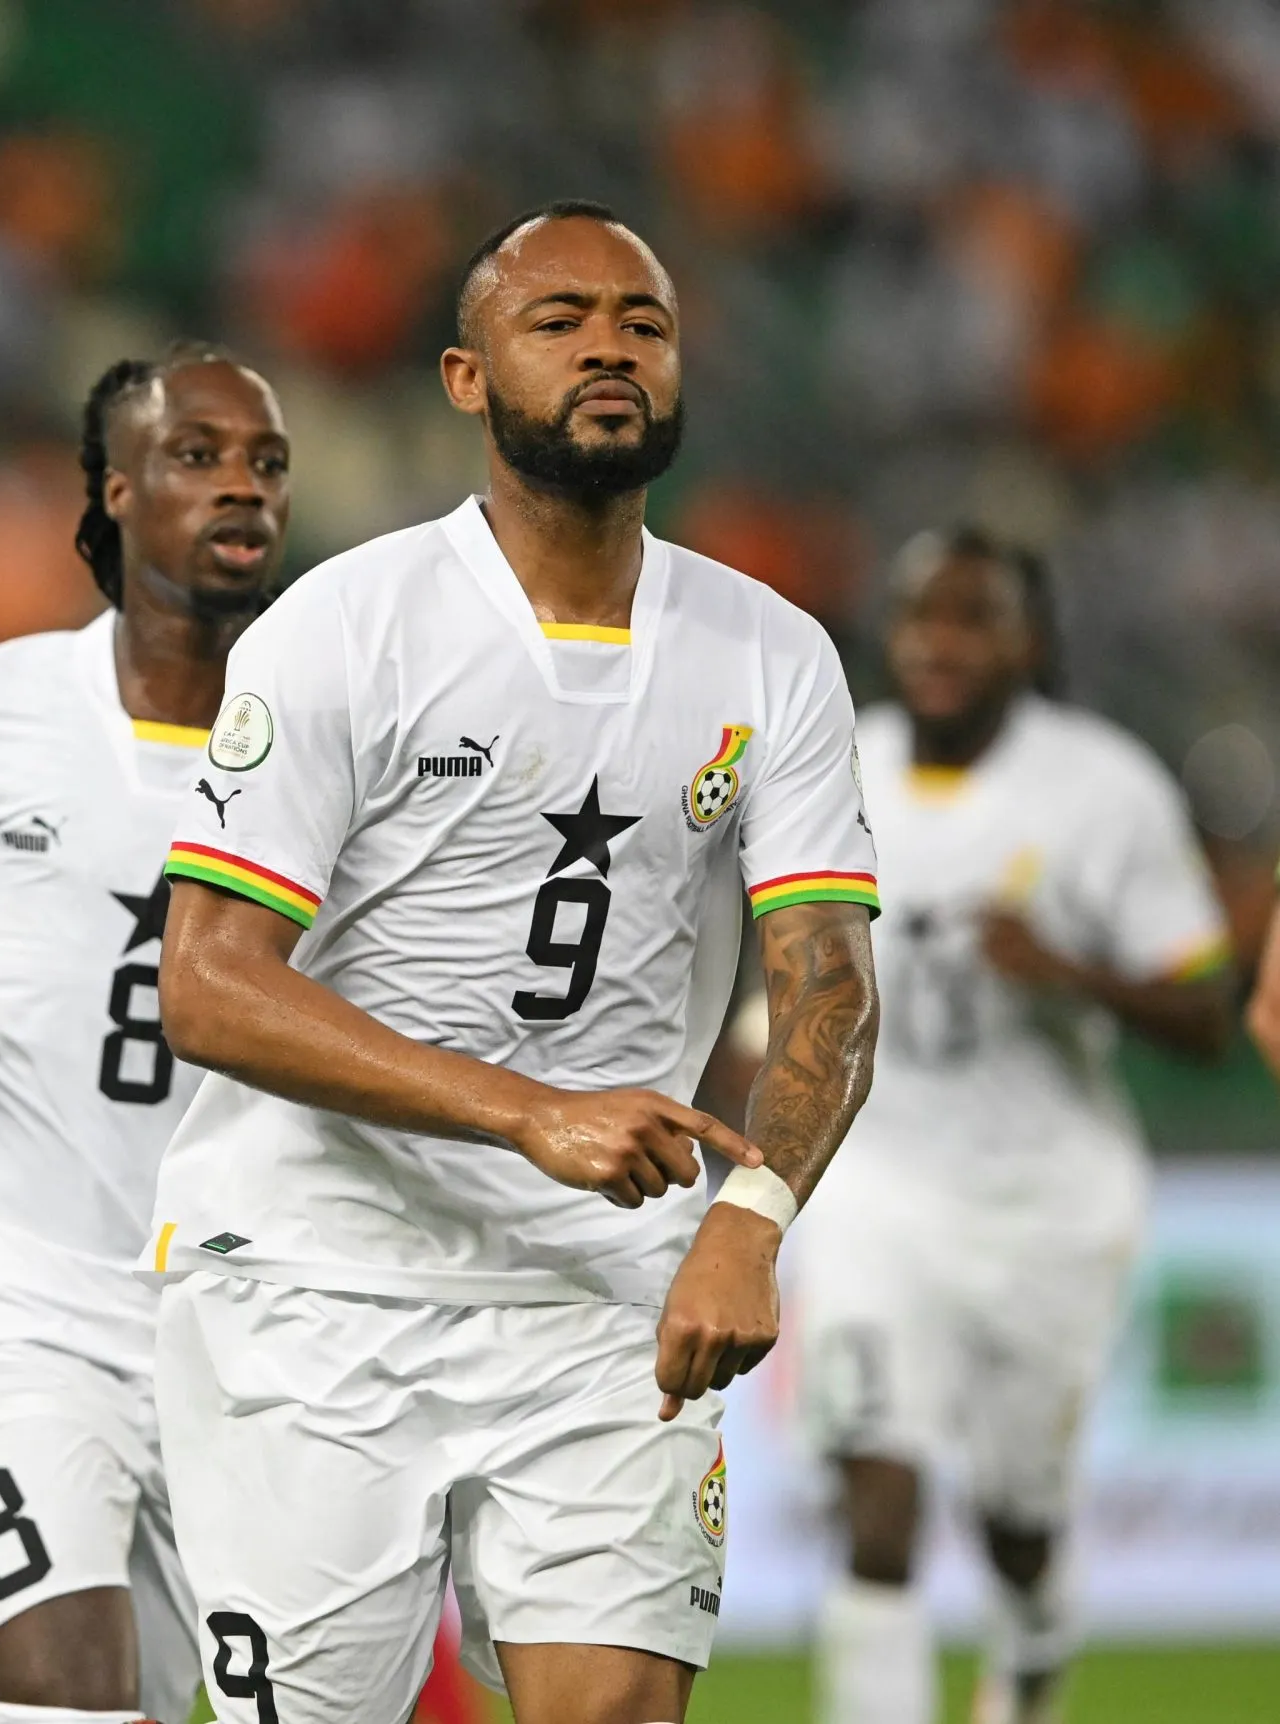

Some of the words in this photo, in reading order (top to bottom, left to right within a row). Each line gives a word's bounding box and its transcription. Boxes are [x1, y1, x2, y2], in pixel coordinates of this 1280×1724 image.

[418, 756, 482, 777] PUMA
[681, 785, 690, 816] GHANA
[511, 876, 612, 1021] 9
[99, 963, 174, 1105] 8
[690, 1585, 721, 1617] PUM
[206, 1611, 279, 1724] 9
